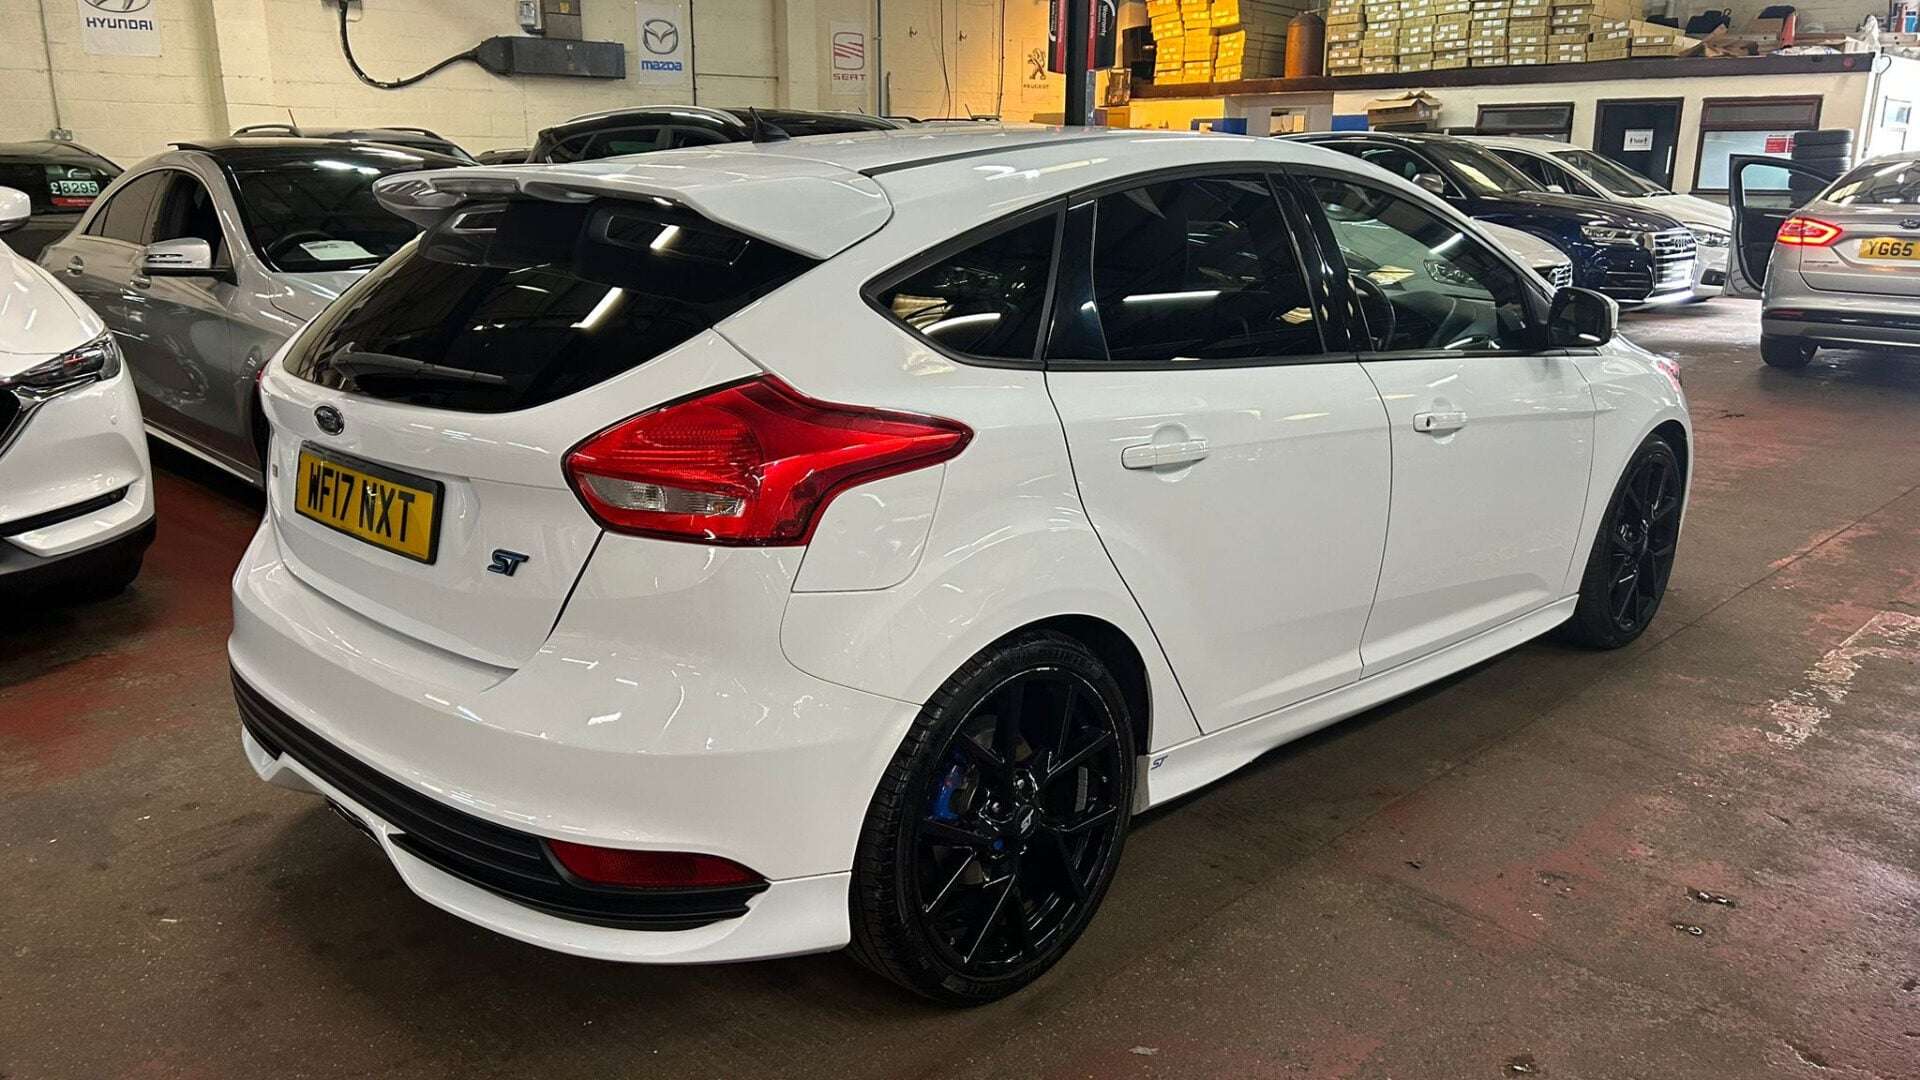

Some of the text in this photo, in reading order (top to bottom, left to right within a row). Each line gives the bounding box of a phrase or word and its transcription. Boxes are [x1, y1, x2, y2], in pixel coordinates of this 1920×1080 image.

[86, 17, 153, 31] HYUNDAI
[641, 60, 682, 72] mazda
[832, 73, 866, 81] SEAT
[50, 181, 98, 195] £8295
[1867, 241, 1915, 257] YG65
[307, 461, 416, 543] WF17 NXT
[487, 548, 530, 577] ST
[1150, 754, 1169, 770] ST
